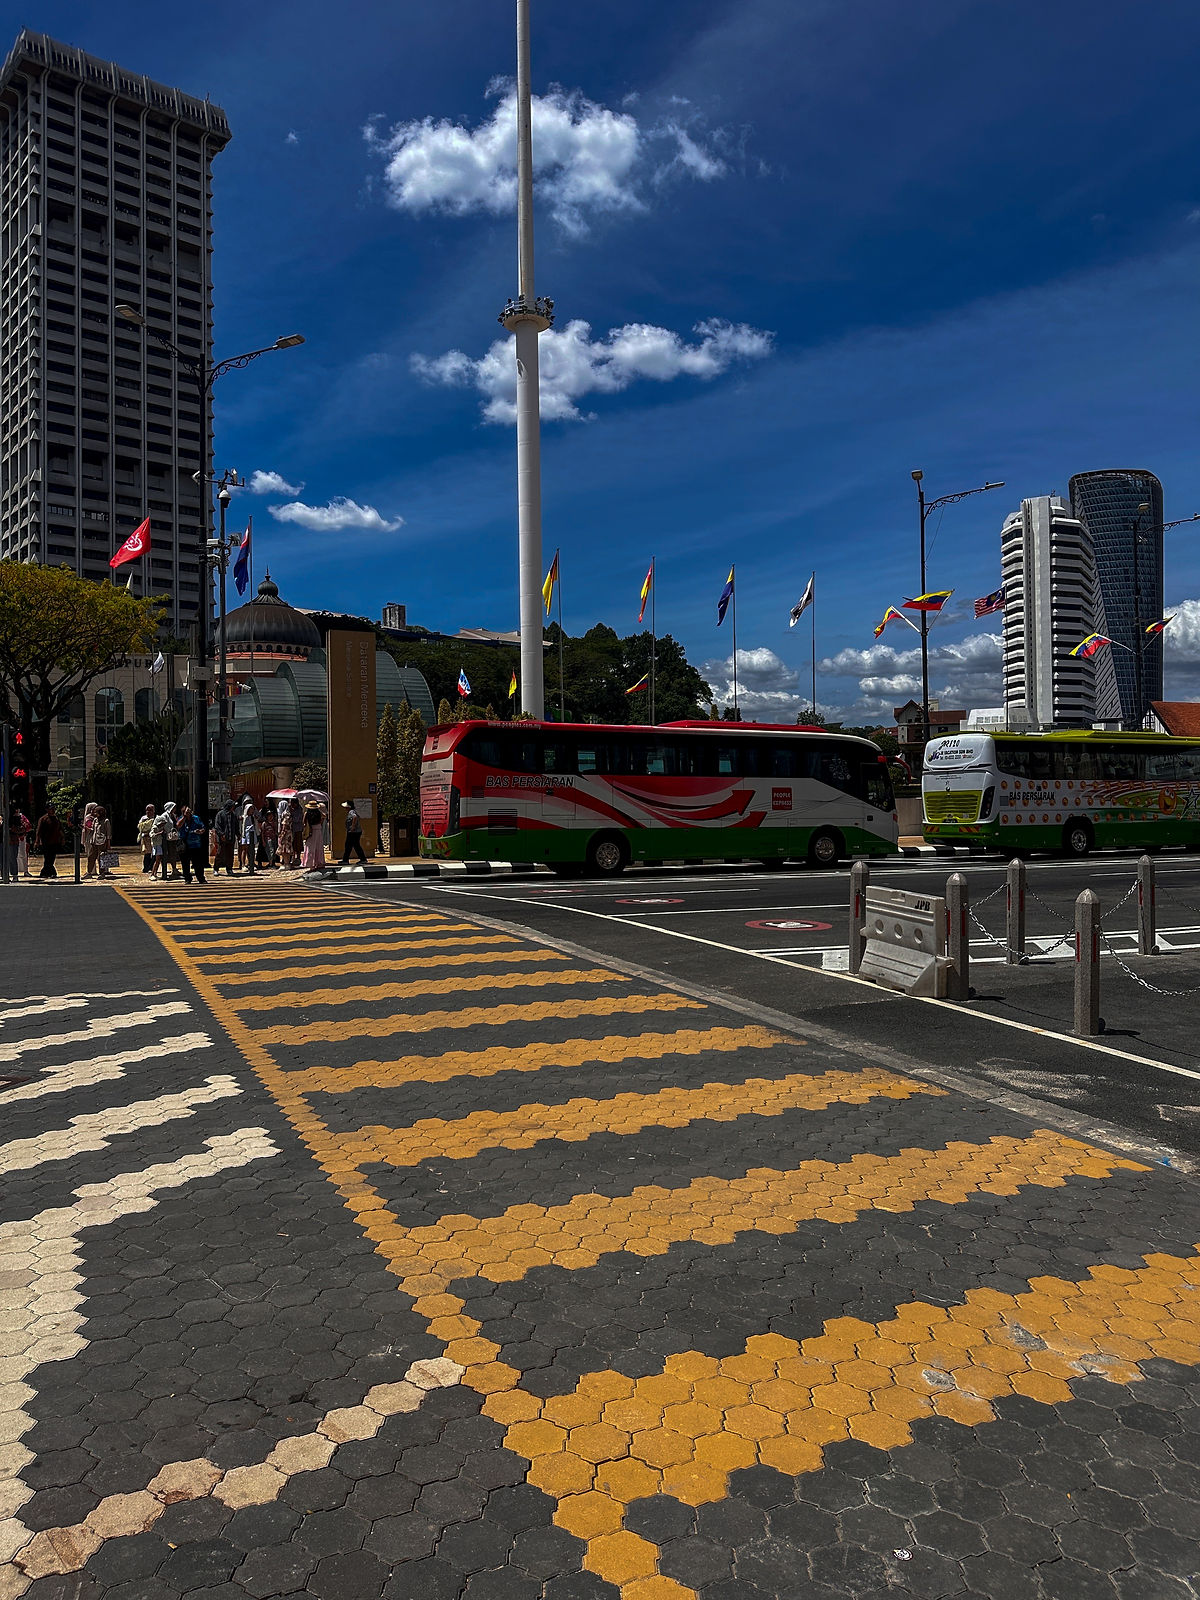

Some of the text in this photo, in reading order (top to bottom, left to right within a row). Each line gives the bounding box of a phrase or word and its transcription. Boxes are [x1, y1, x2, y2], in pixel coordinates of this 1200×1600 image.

[359, 640, 369, 682] Dataran
[486, 775, 575, 788] BAS PERSIARAN
[1009, 791, 1055, 800] BAS PERSIARAN
